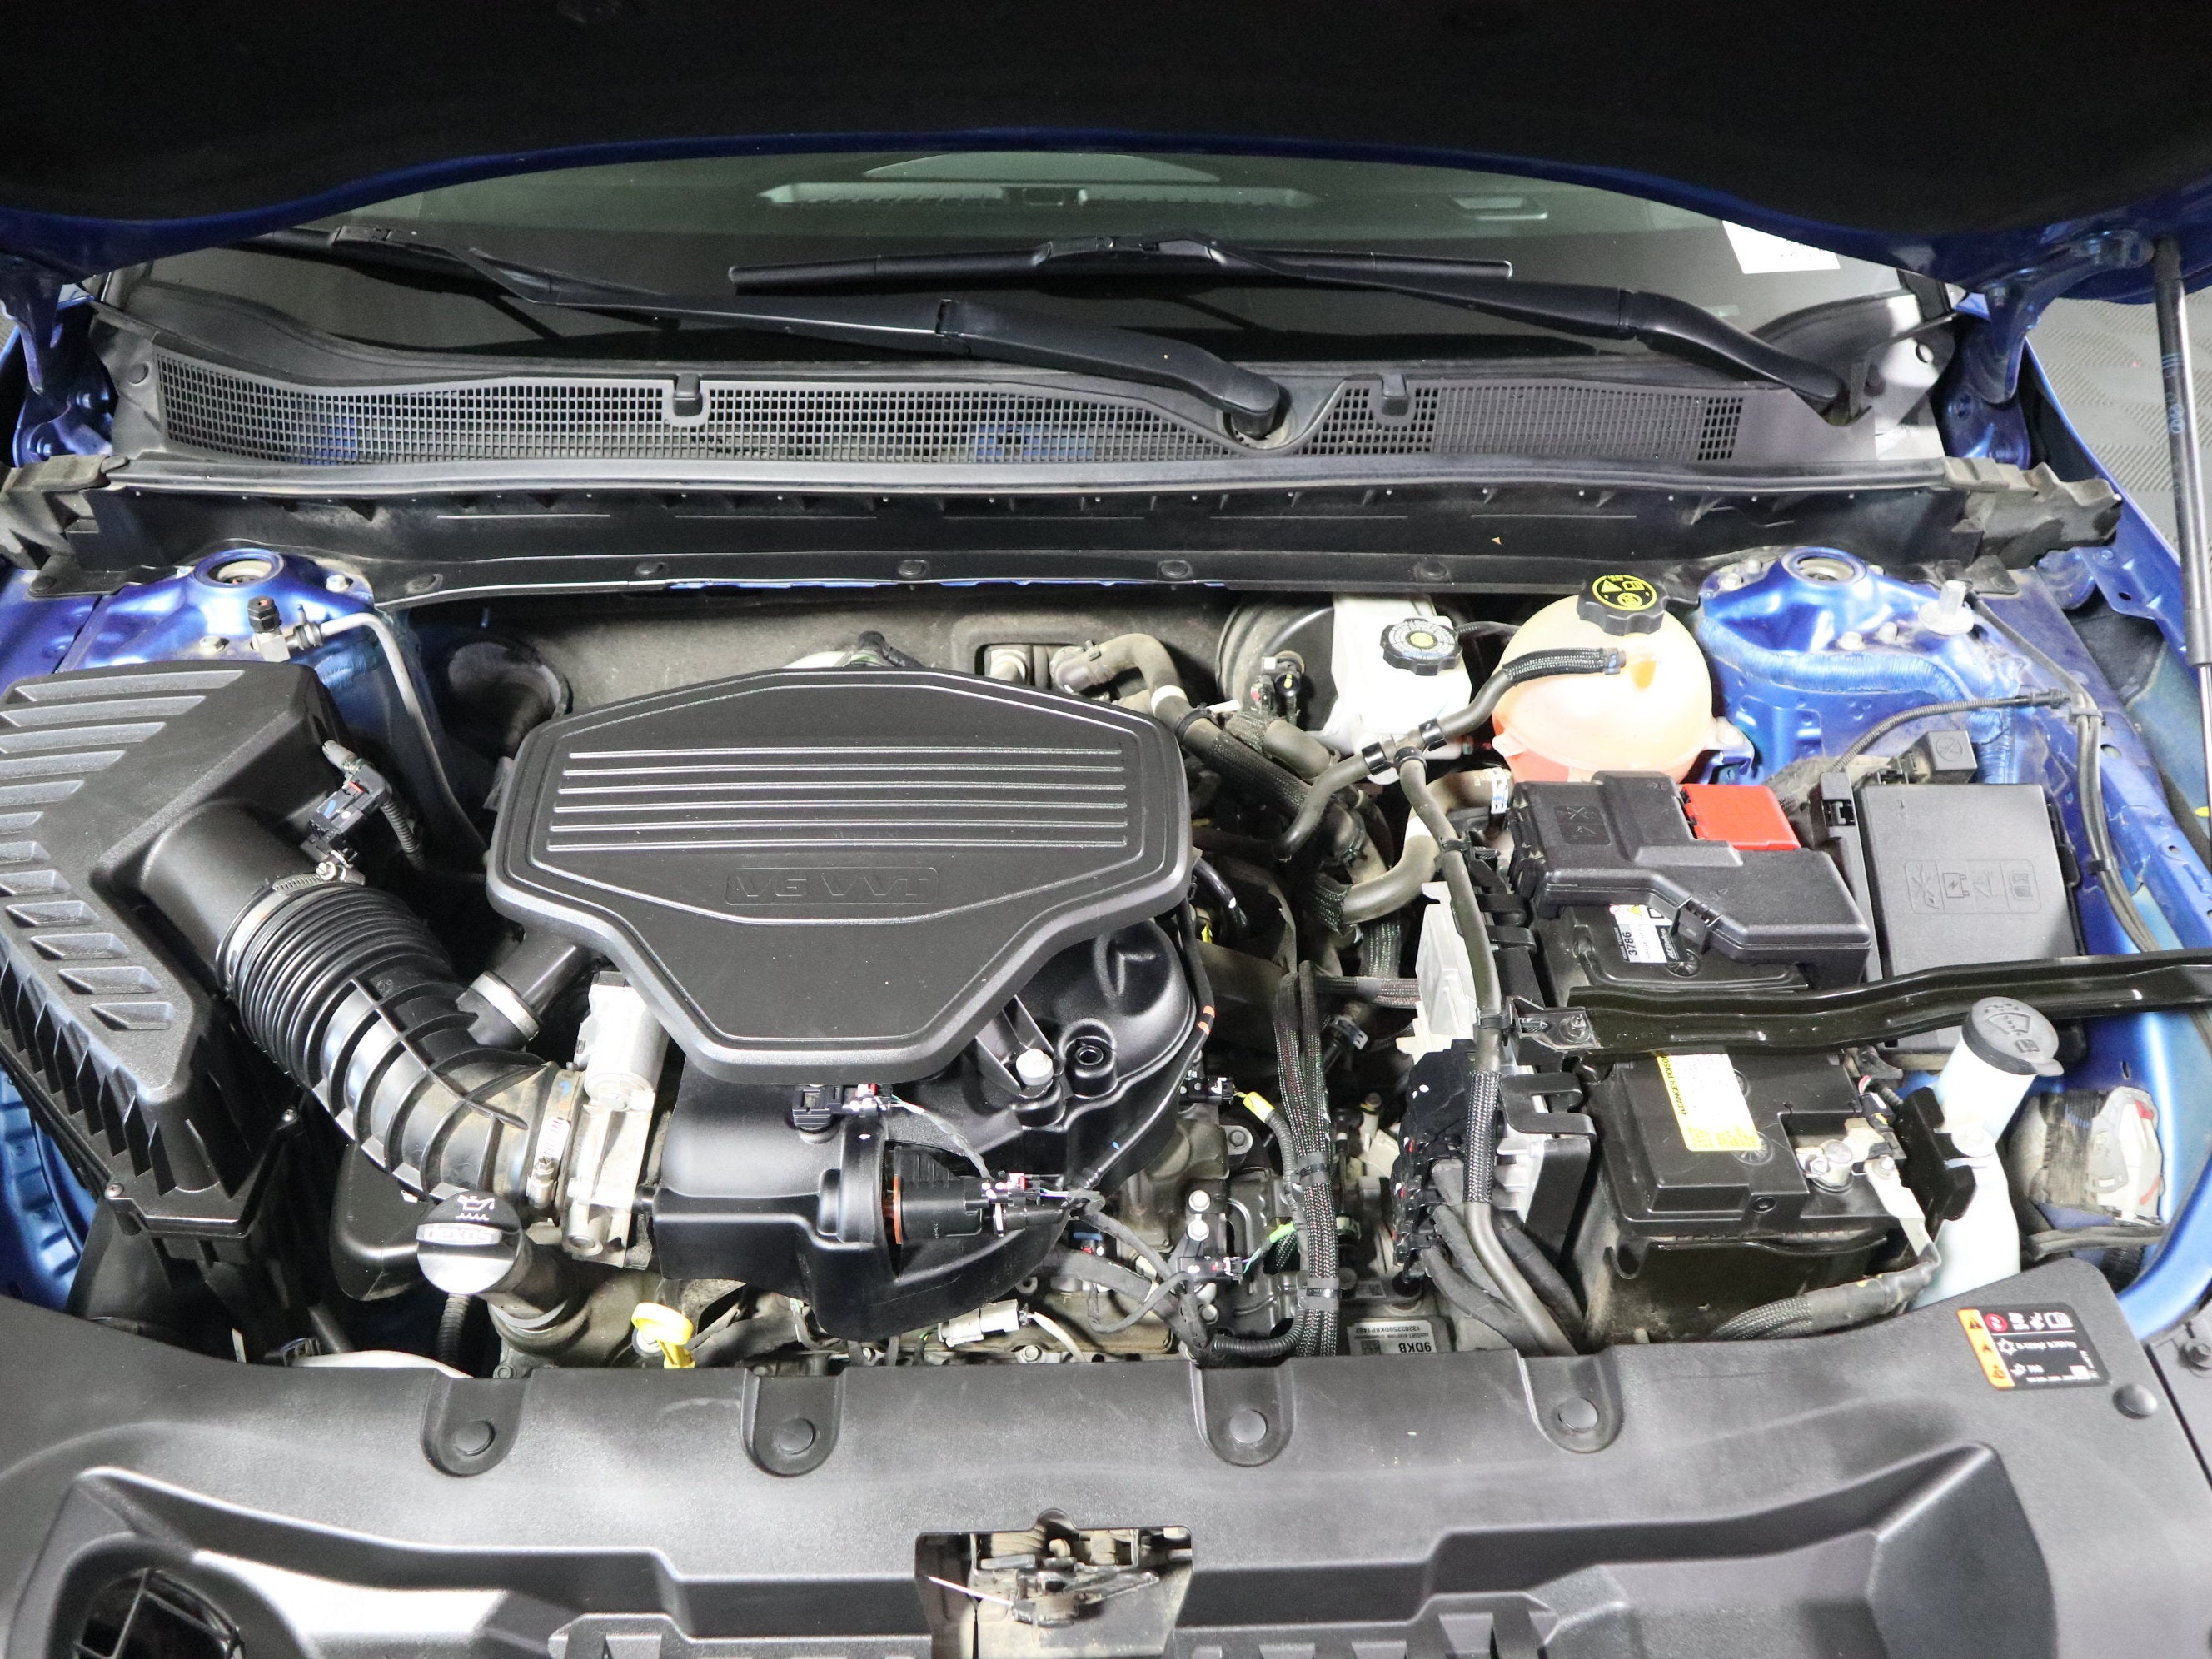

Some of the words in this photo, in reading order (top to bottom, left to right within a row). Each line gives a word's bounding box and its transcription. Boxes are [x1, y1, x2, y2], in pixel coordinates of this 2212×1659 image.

[735, 874, 809, 897] V6
[820, 873, 929, 897] VVT
[1622, 931, 1638, 957] 3786
[423, 1224, 493, 1243] dexos
[1398, 1342, 1432, 1353] 9DKB
